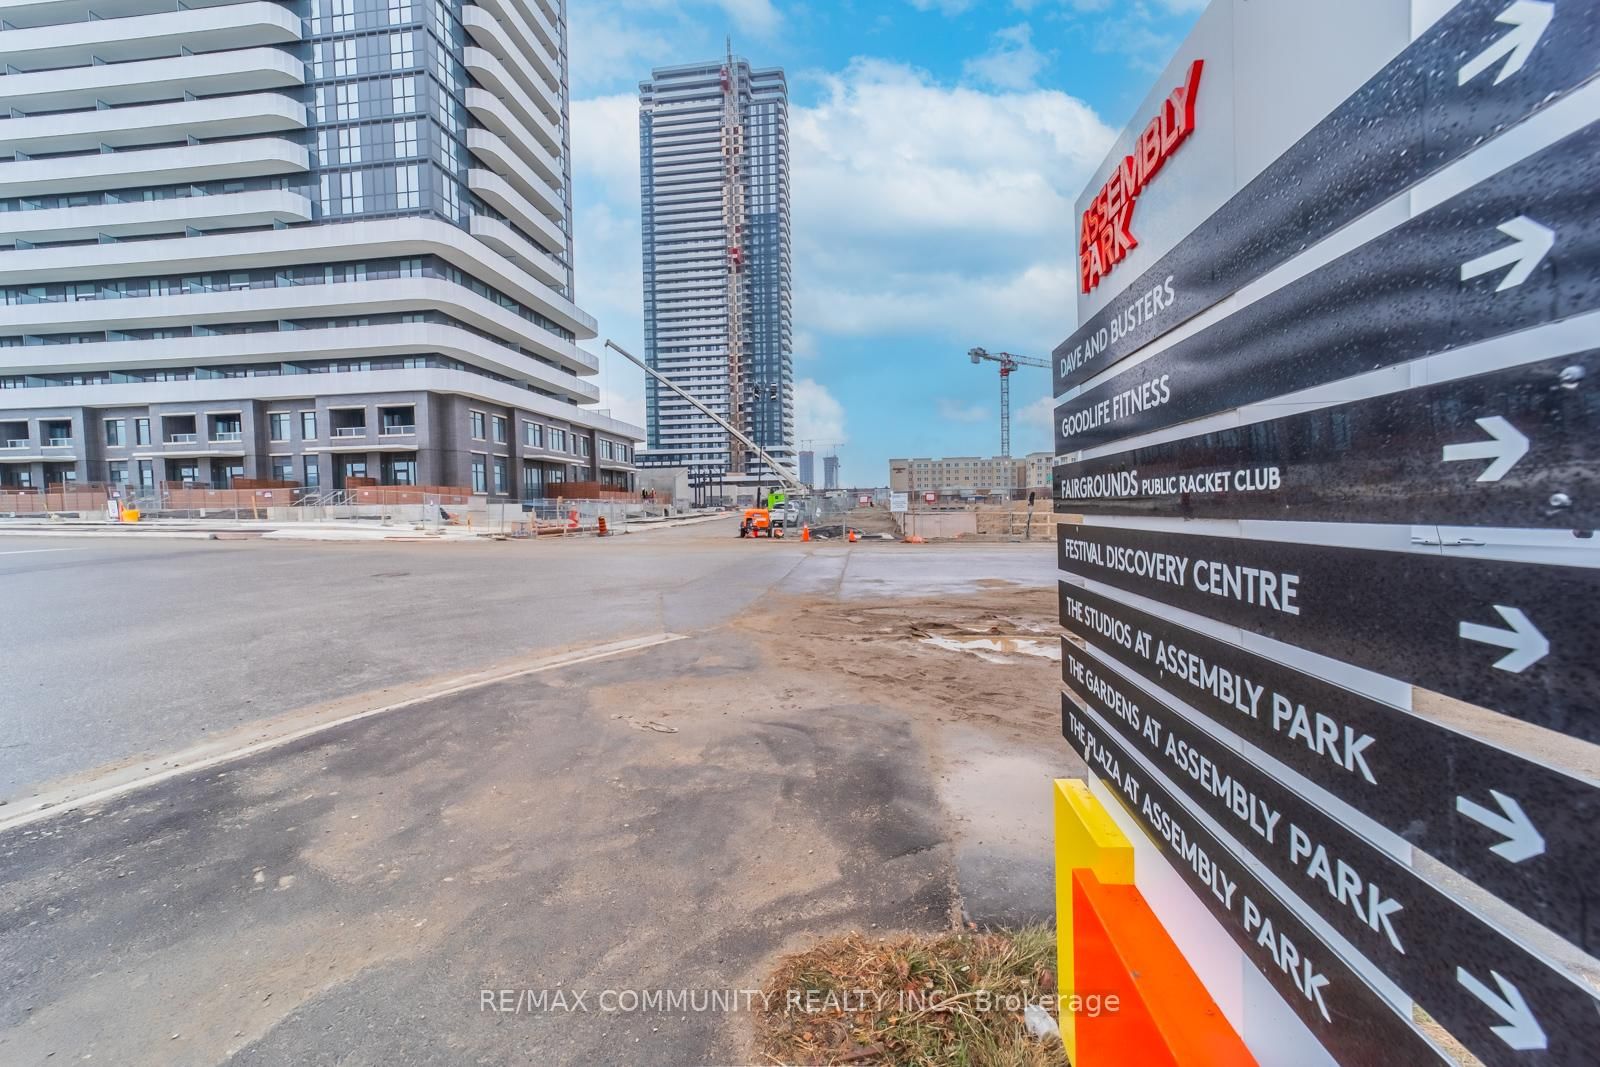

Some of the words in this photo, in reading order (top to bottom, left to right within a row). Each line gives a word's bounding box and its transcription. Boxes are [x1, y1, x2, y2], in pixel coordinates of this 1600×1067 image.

[1079, 60, 1204, 253] ASSEMBLY
[1080, 200, 1138, 294] PARK
[1060, 345, 1083, 378] DAVE
[1084, 327, 1107, 362] AND
[1110, 275, 1175, 344] BUSTERS
[1062, 400, 1110, 438] GOODLIFE
[1113, 374, 1170, 421] FITNESS
[1061, 470, 1138, 499] FAIRGROUNDS
[1142, 477, 1177, 495] PUBLIC
[1179, 471, 1231, 493] RACKET
[1234, 466, 1281, 491] CLUB
[1065, 538, 1104, 566] FESTIVAL
[1106, 545, 1189, 586] DISCOVERY
[1193, 559, 1300, 616] CENTRE
[1066, 596, 1083, 623] THE
[1084, 604, 1132, 649] STUDIOS
[1134, 630, 1152, 660] AT
[1156, 640, 1265, 719] ASSEMBLY
[1272, 692, 1378, 785] PARK
[1068, 654, 1085, 684] THE
[1085, 671, 1140, 731] GARDENS
[1143, 714, 1162, 748] AT
[1165, 732, 1281, 844] ASSEMBLY
[1289, 823, 1406, 955] PARK
[1069, 711, 1086, 746] THE
[1087, 731, 1122, 787] PLAZA
[1124, 773, 1140, 804] AT
[1142, 793, 1237, 910] ASSEMBLY
[1243, 895, 1332, 1023] PARK
